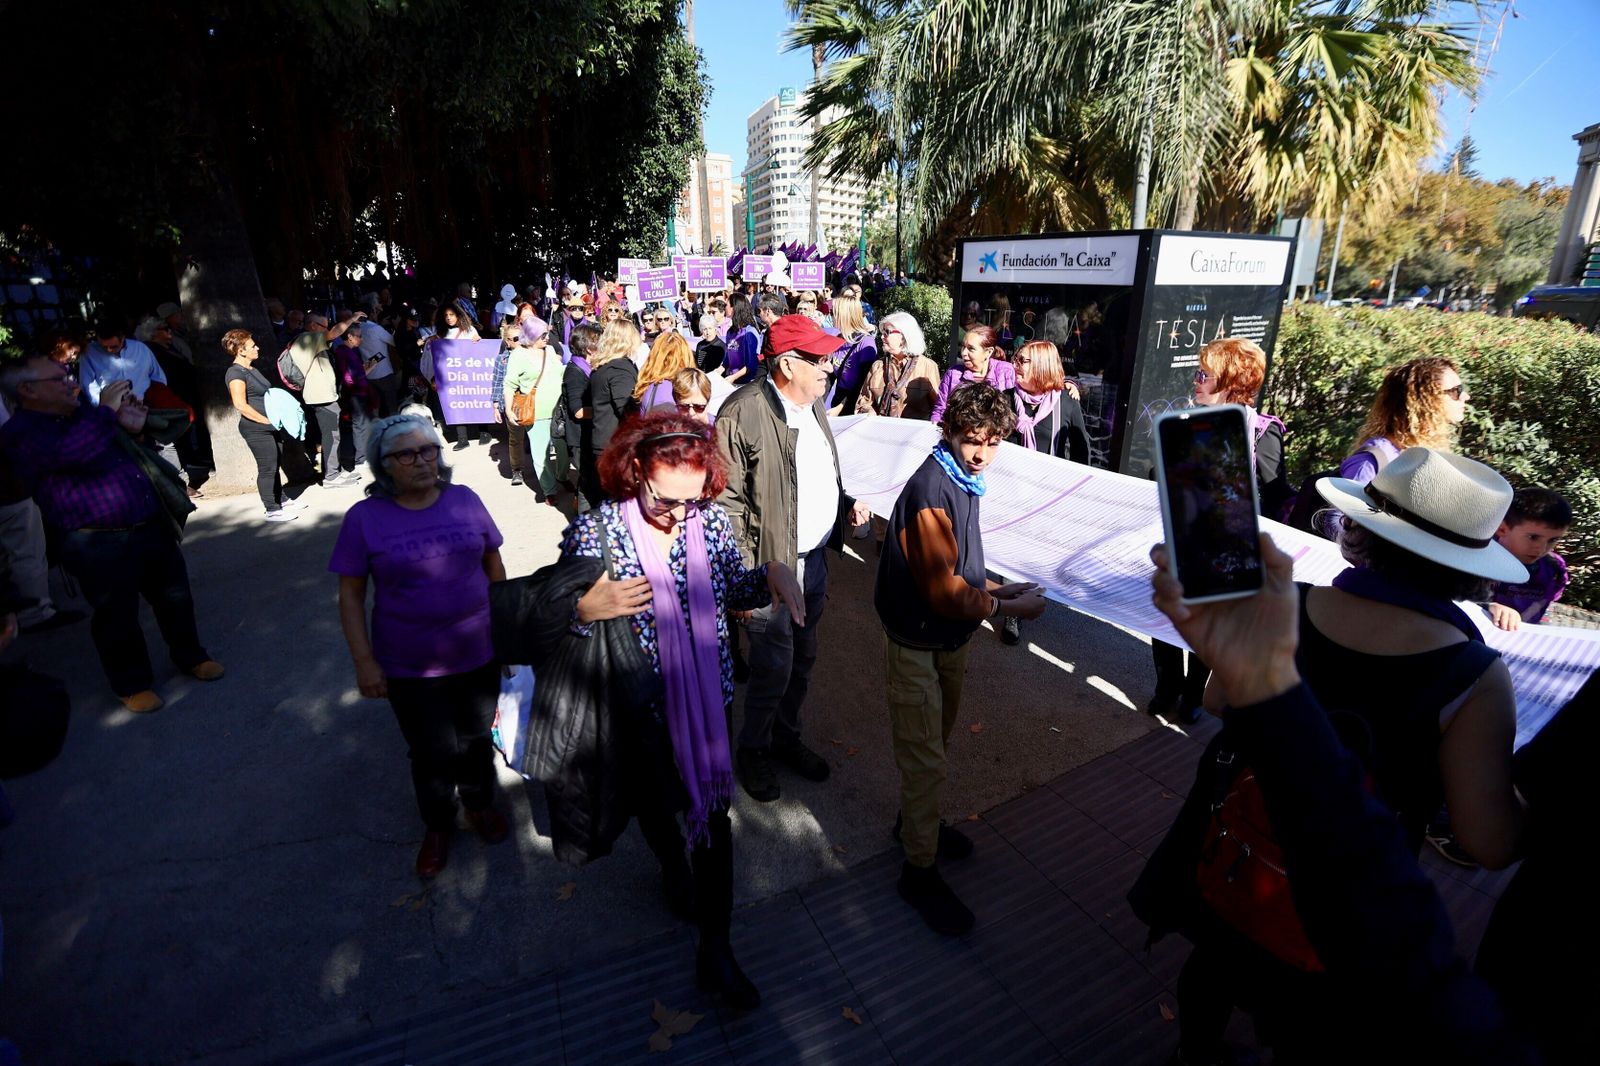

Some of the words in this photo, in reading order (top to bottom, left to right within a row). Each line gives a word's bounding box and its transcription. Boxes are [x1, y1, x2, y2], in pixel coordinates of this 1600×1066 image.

[781, 88, 794, 97] AC
[1002, 252, 1057, 267] Fundación
[1190, 249, 1266, 273] CaixaForum
[807, 265, 817, 276] NO
[693, 279, 700, 287] TE
[644, 291, 652, 299] TE
[1155, 314, 1225, 349] TESLA
[446, 357, 462, 368] 25
[465, 357, 481, 368] de
[448, 370, 468, 382] Día
[449, 399, 492, 409] contra
